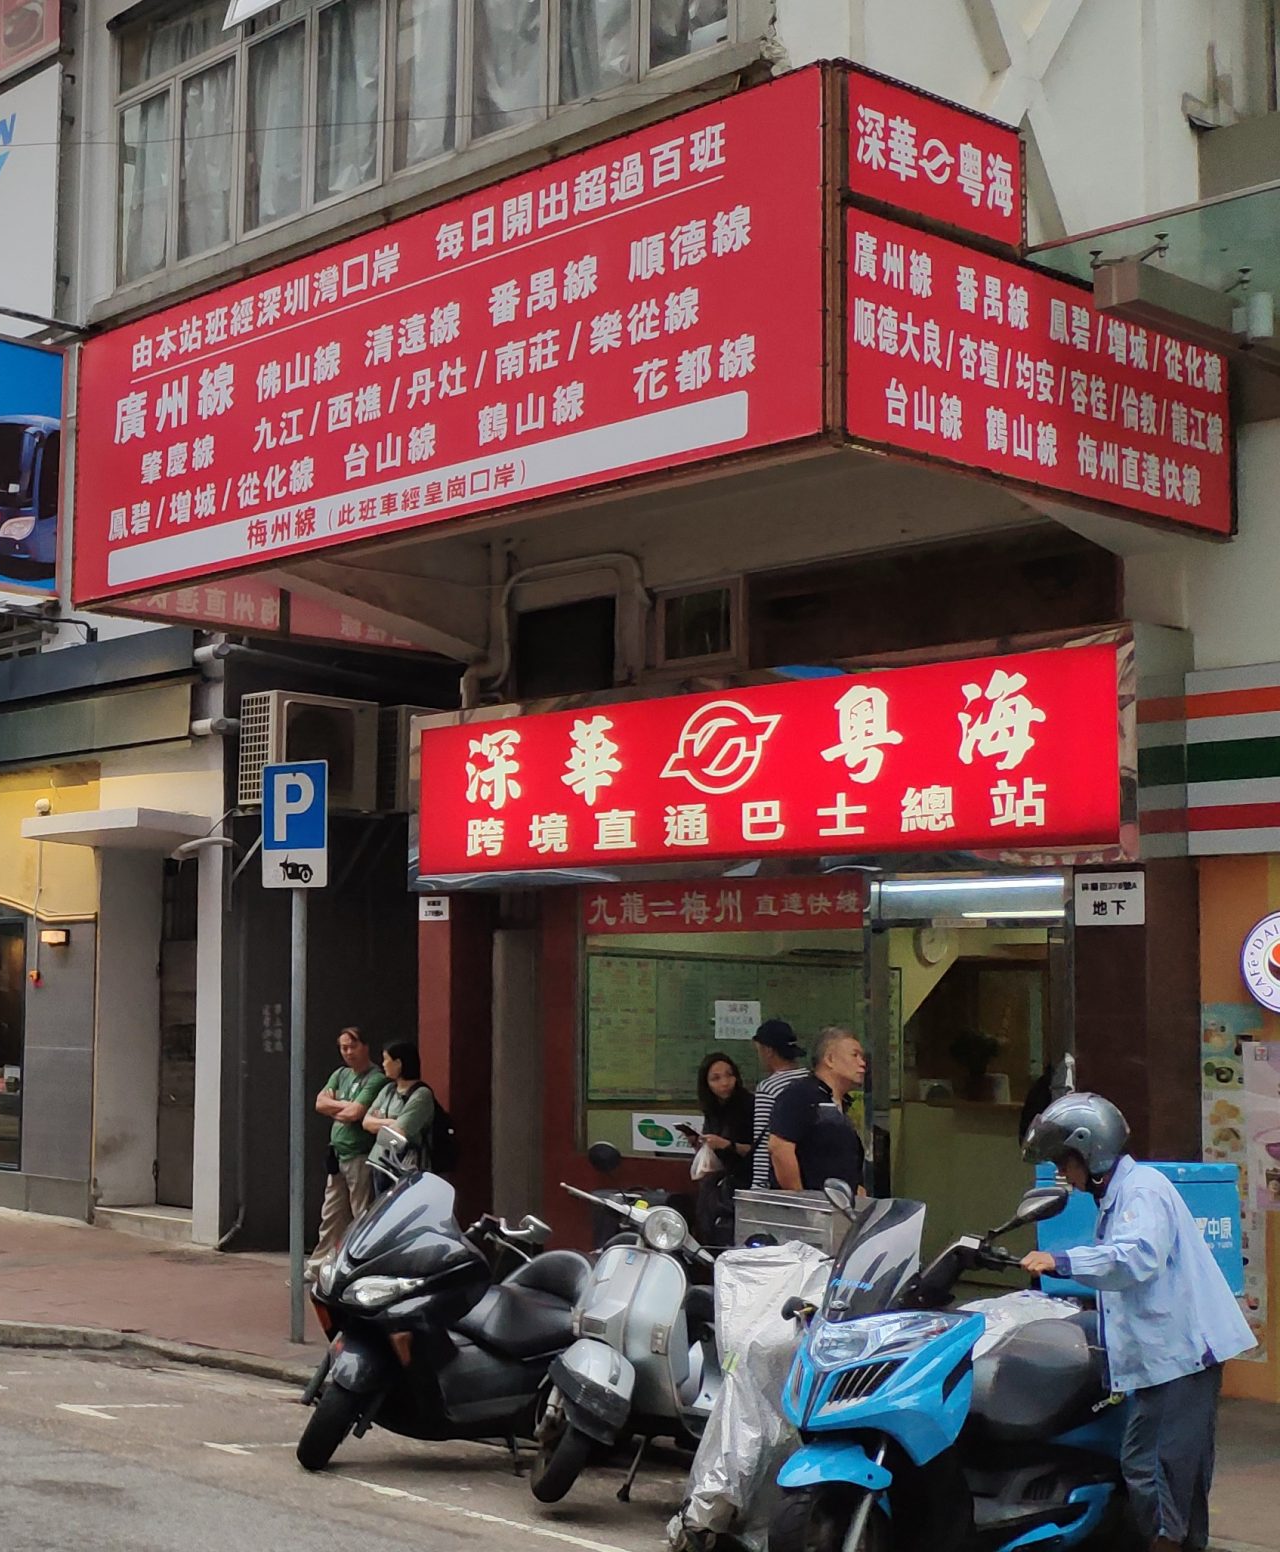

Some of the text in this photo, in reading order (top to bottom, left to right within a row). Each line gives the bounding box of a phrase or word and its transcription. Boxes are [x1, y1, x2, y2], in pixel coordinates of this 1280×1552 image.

[856, 104, 918, 182] 深華
[131, 122, 726, 373] 由本站班經深圳灣口岸 每日開出超過百班
[854, 230, 933, 299] 廣州線
[956, 265, 1029, 331] 番禺線
[114, 204, 752, 445] 廣州線 佛山線 清遠線 番禺線 順德線
[343, 422, 436, 481] 台山線
[478, 380, 585, 447] 鶴山線
[633, 333, 756, 404] 花都線
[885, 377, 1201, 507] 台山線 鶴山線 梅州直達快線
[141, 435, 215, 485] 肇慶線
[247, 506, 317, 550] 梅州線
[465, 715, 622, 811] 深華
[273, 773, 315, 842] P
[466, 777, 1046, 857] 跨境直通巴士總站
[1093, 900, 1126, 915] 地下
